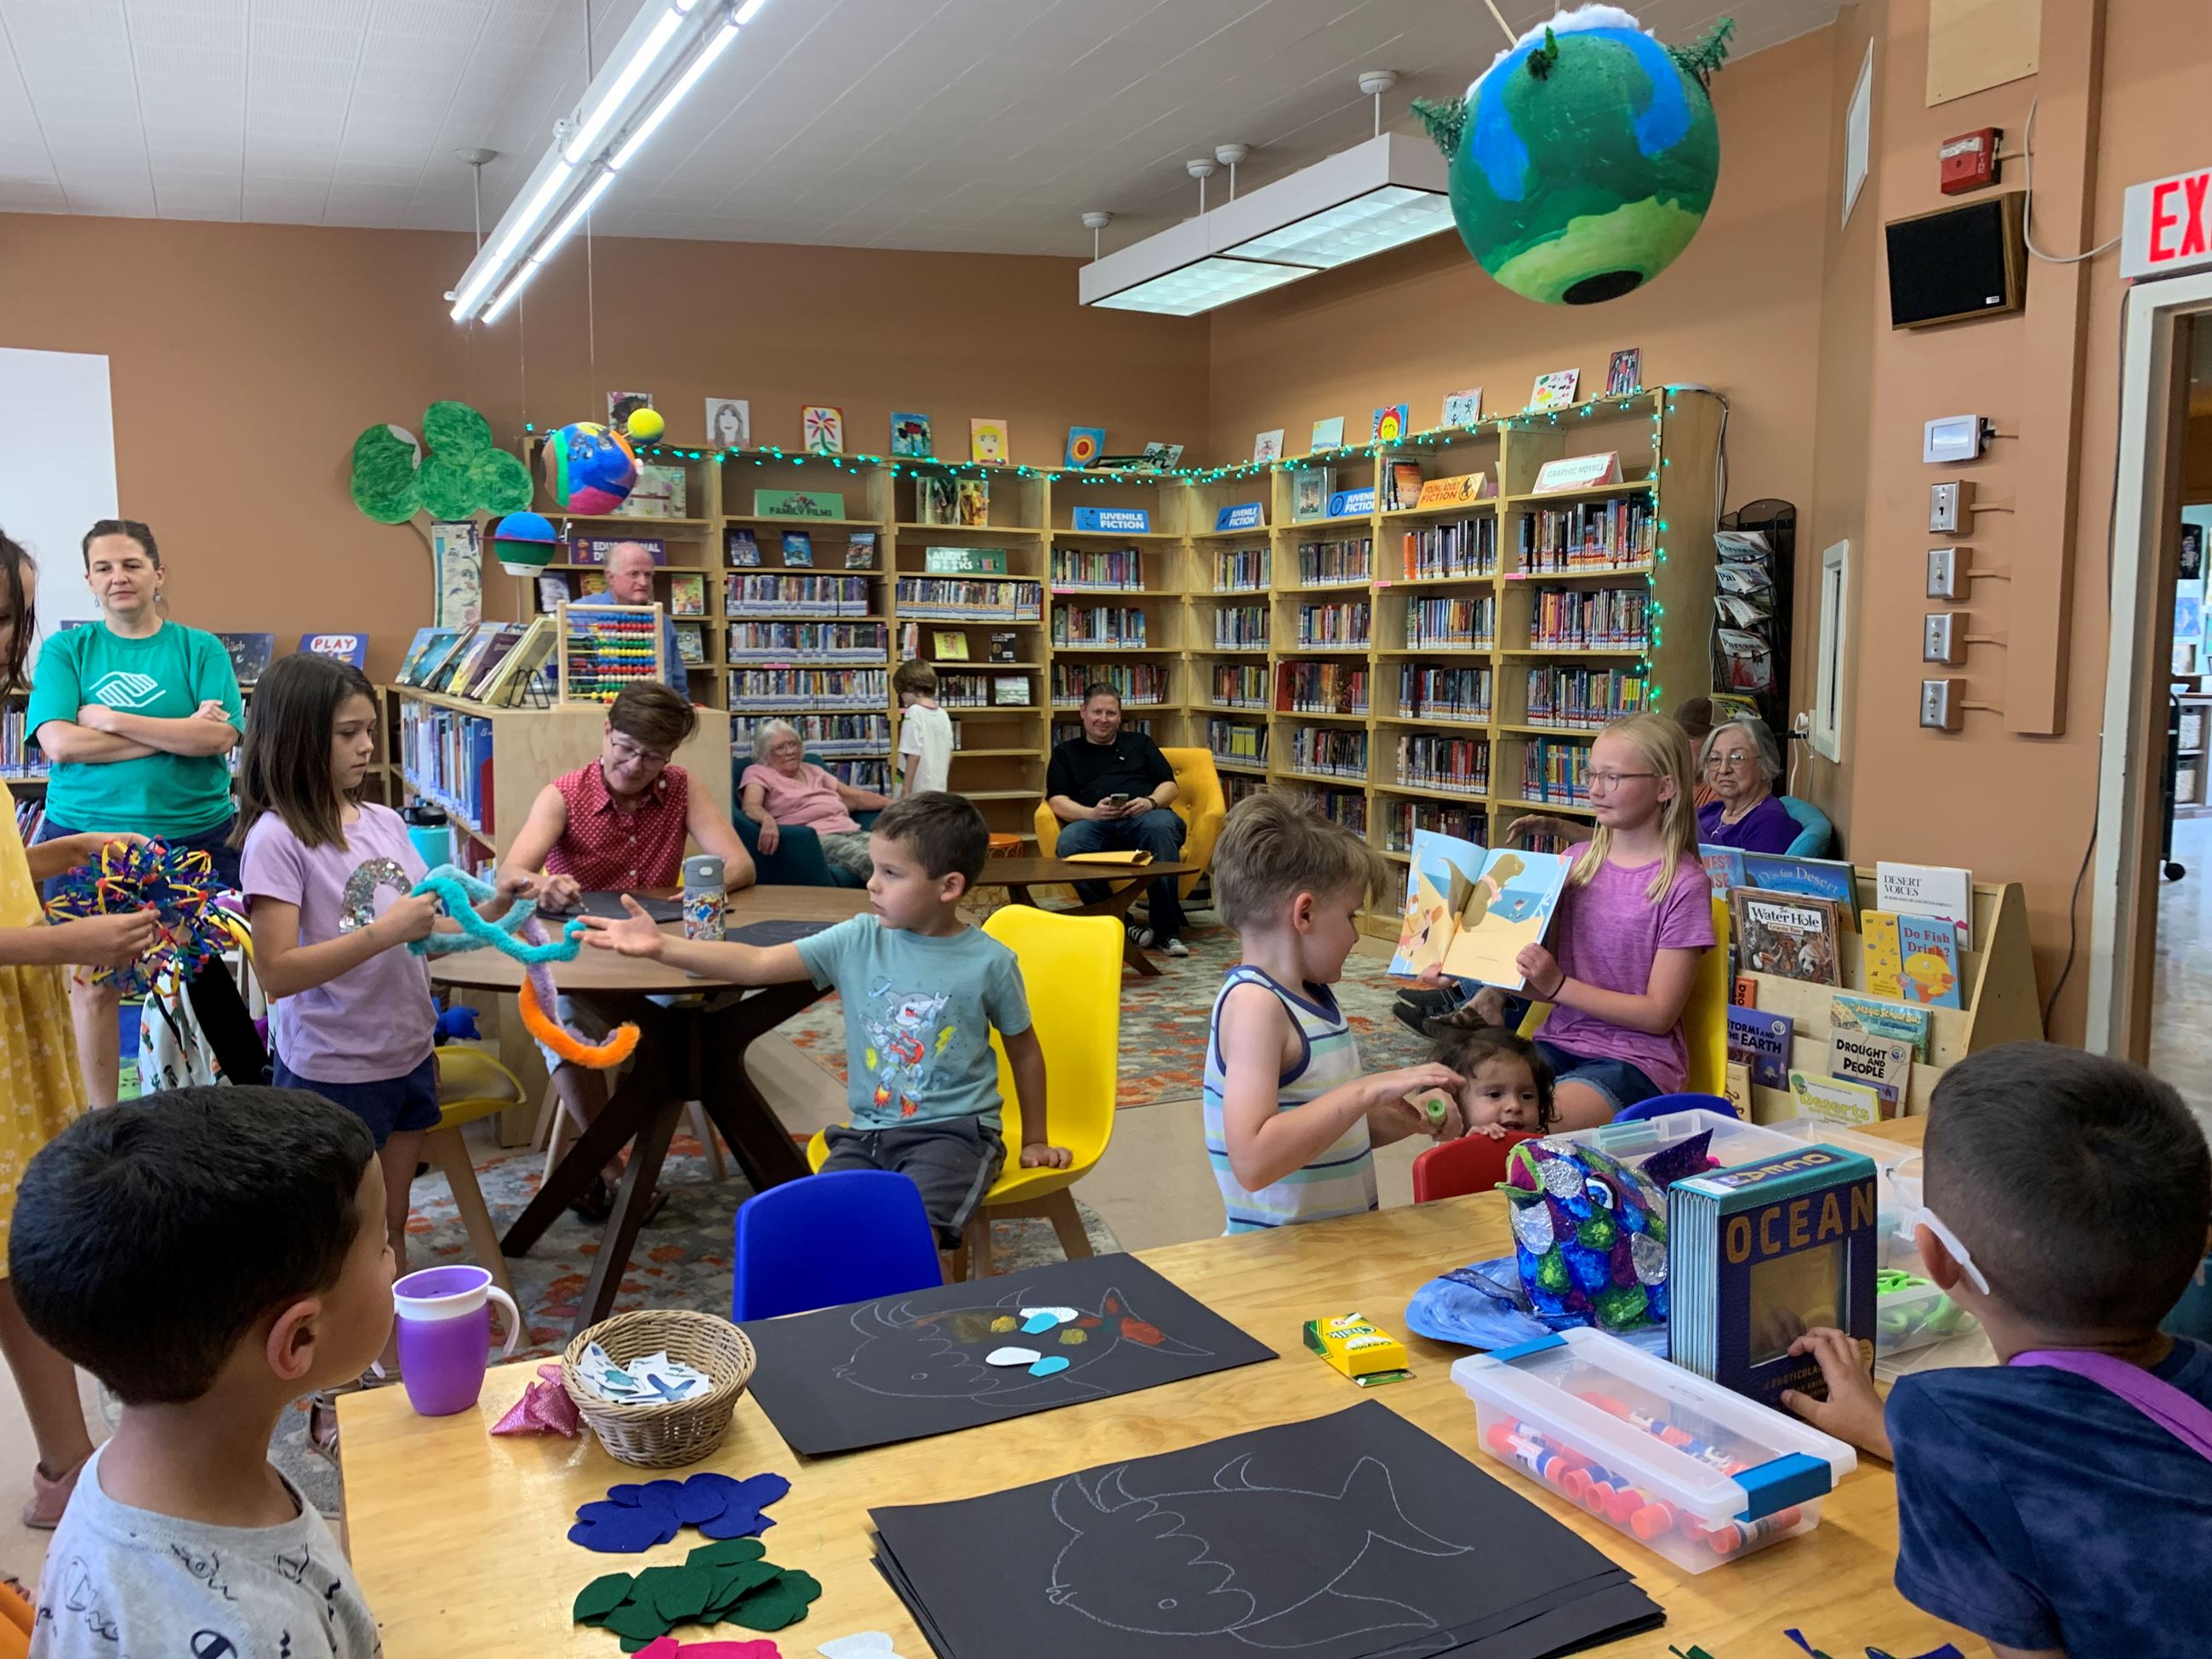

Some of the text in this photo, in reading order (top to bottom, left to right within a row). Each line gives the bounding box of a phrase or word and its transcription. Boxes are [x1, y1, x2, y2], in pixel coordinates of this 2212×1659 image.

[2149, 173, 2212, 263] EX
[1547, 463, 1605, 478] GRAPHIC NOVELS
[1425, 484, 1442, 493] YOUNG
[1347, 492, 1375, 504] JUVENIL
[1421, 491, 1457, 504] FICTION
[769, 506, 832, 516] FAMILY FILMS
[1099, 512, 1143, 521] JUVENILE
[1230, 507, 1257, 518] JUVENILE
[1100, 521, 1144, 529] FICTION
[1229, 516, 1257, 527] FICTION
[314, 638, 354, 650] PLAY
[1702, 854, 1730, 871] WEST
[1797, 866, 1838, 894] Desert
[1884, 875, 1923, 887] DESERT
[1884, 884, 1919, 897] VOICES
[1751, 906, 1820, 928] Water Hole
[1904, 926, 1951, 944] Do Fish
[1737, 983, 1747, 1006] DRO
[1879, 1007, 1905, 1022] School
[1728, 1018, 1776, 1040] TORMS AND
[1728, 1030, 1782, 1054] HE EARTH
[1836, 1039, 1888, 1060] DROUGHT
[1843, 1057, 1885, 1079] PEOPLE
[1867, 1058, 1886, 1068] AND
[1799, 1091, 1870, 1121] Deserts
[1725, 1182, 1873, 1264] OCEAN
[1329, 1325, 1377, 1339] Chalk
[1349, 1341, 1393, 1351] Crayola
